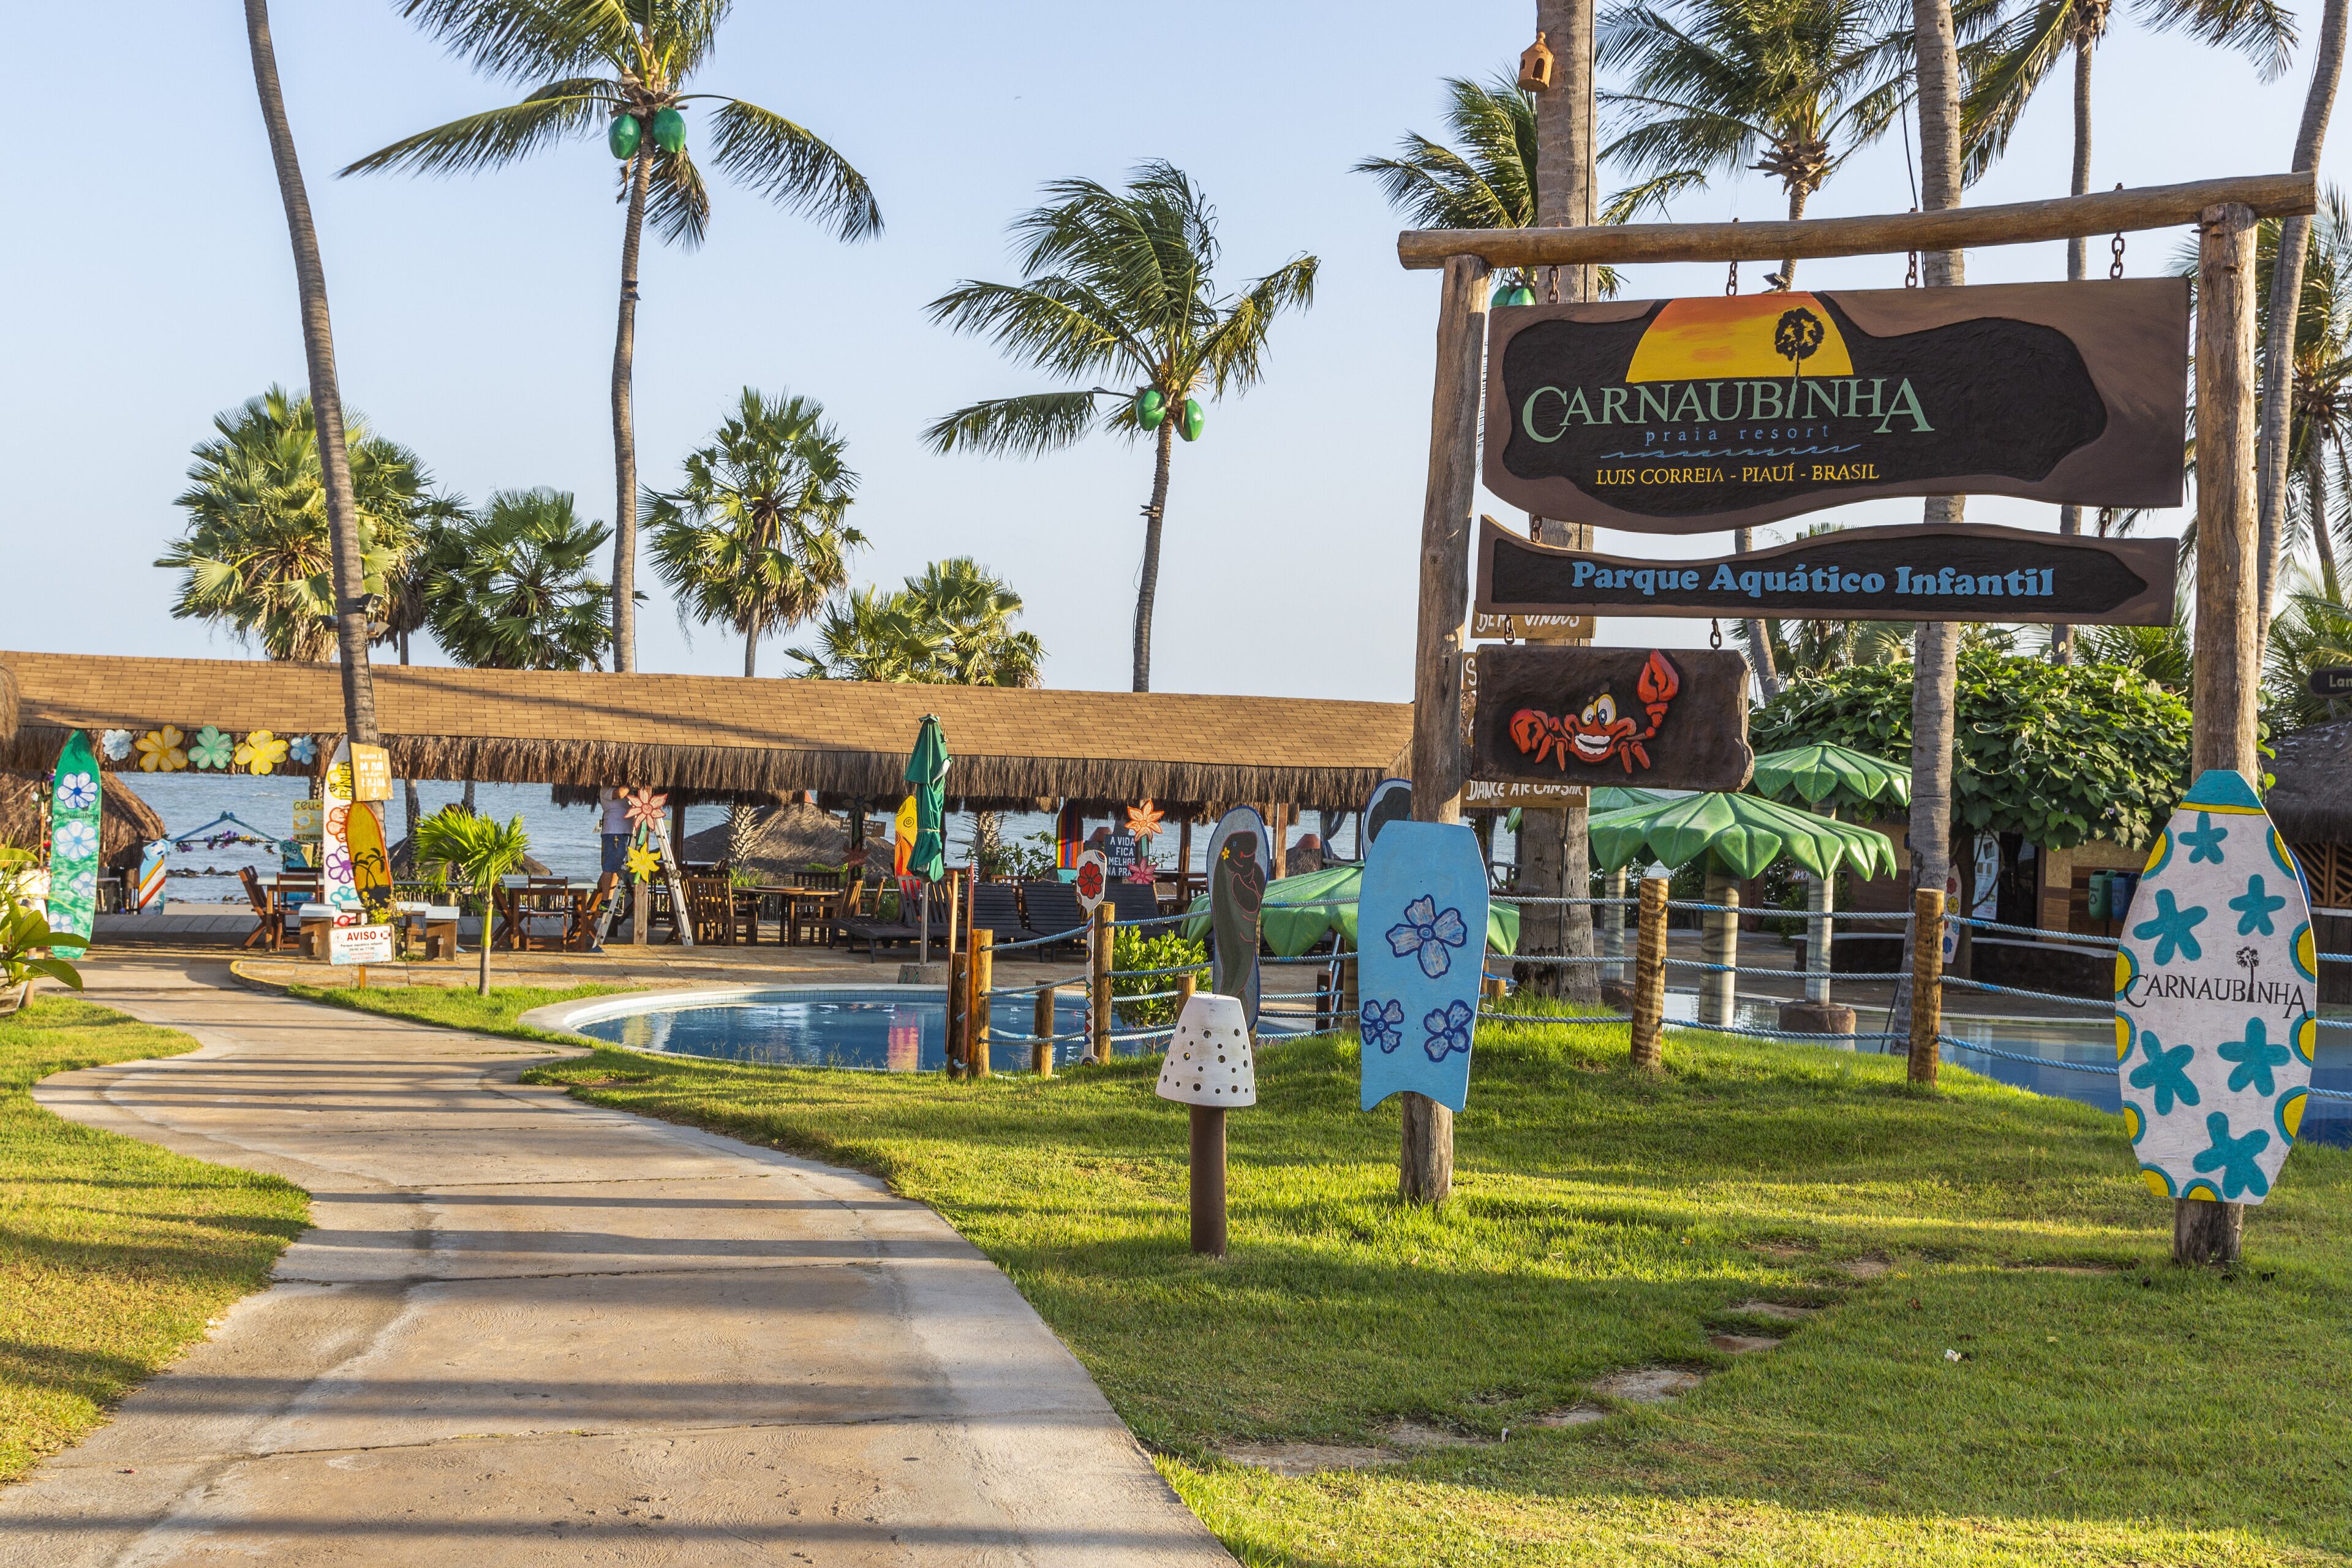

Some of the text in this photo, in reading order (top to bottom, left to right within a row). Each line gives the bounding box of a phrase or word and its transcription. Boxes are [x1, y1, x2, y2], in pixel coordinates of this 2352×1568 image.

[1523, 377, 1935, 443] CARNAUBINHA
[1645, 425, 1828, 446] praia resort
[1596, 469, 1635, 484] LUIS
[1640, 467, 1724, 484] CORREIA
[1742, 462, 1795, 482] PIAUÍ
[1811, 464, 1880, 480] BRASIL
[1572, 561, 2054, 598] Parque Aquático Infantil
[360, 762, 369, 771] DO
[1466, 780, 1505, 801] DANCE
[1110, 836, 1136, 846] A VIDA
[1116, 847, 1134, 856] FICA
[1107, 867, 1116, 876] NA
[347, 930, 377, 941] AVISO
[2123, 973, 2310, 1019] CARNAUBINHA
